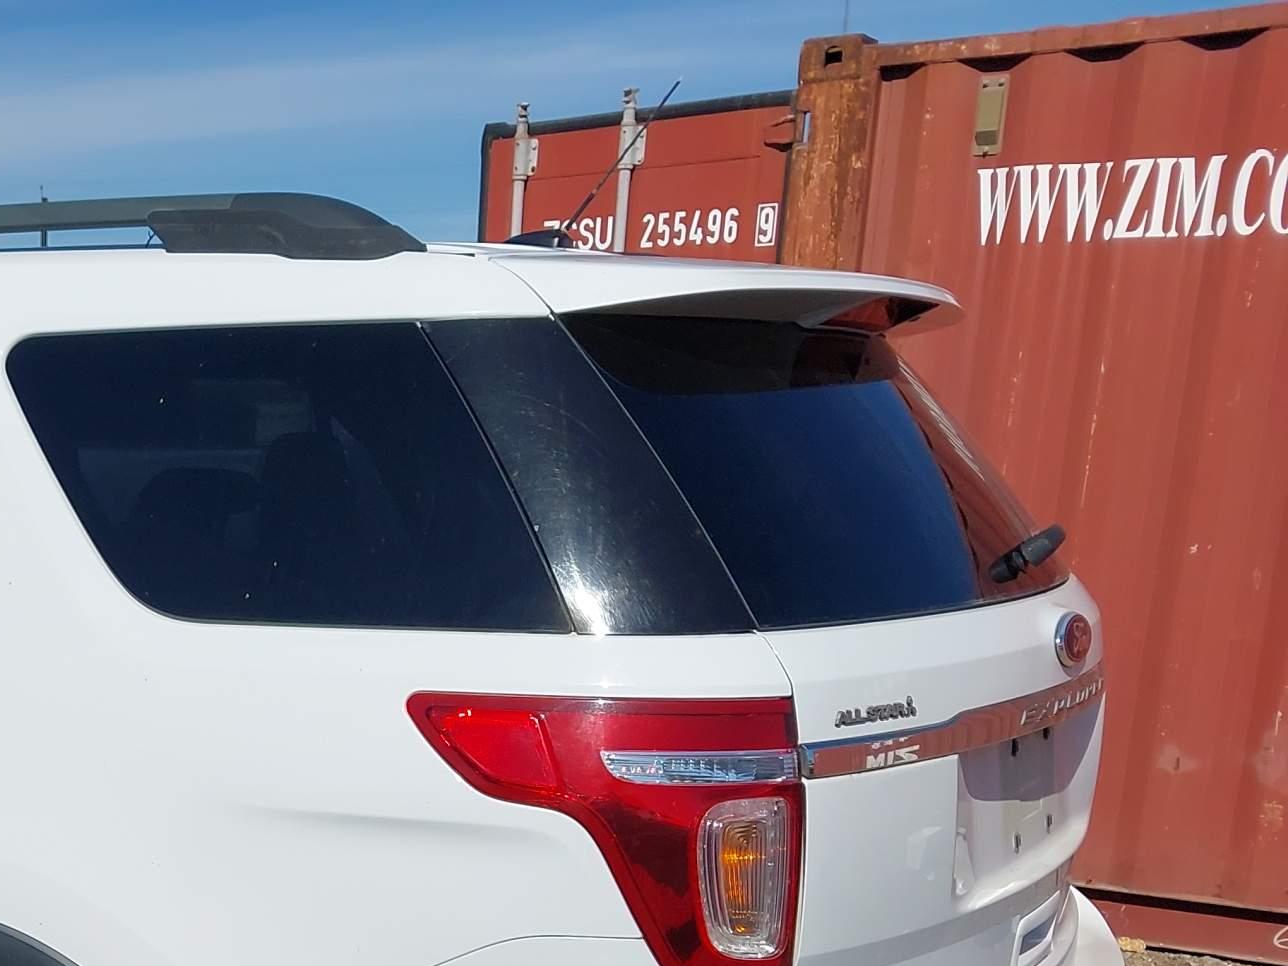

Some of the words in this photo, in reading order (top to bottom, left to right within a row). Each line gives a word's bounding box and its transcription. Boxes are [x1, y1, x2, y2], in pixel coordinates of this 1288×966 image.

[543, 215, 614, 250] SU
[639, 207, 740, 249] 255496
[757, 204, 777, 245] 9
